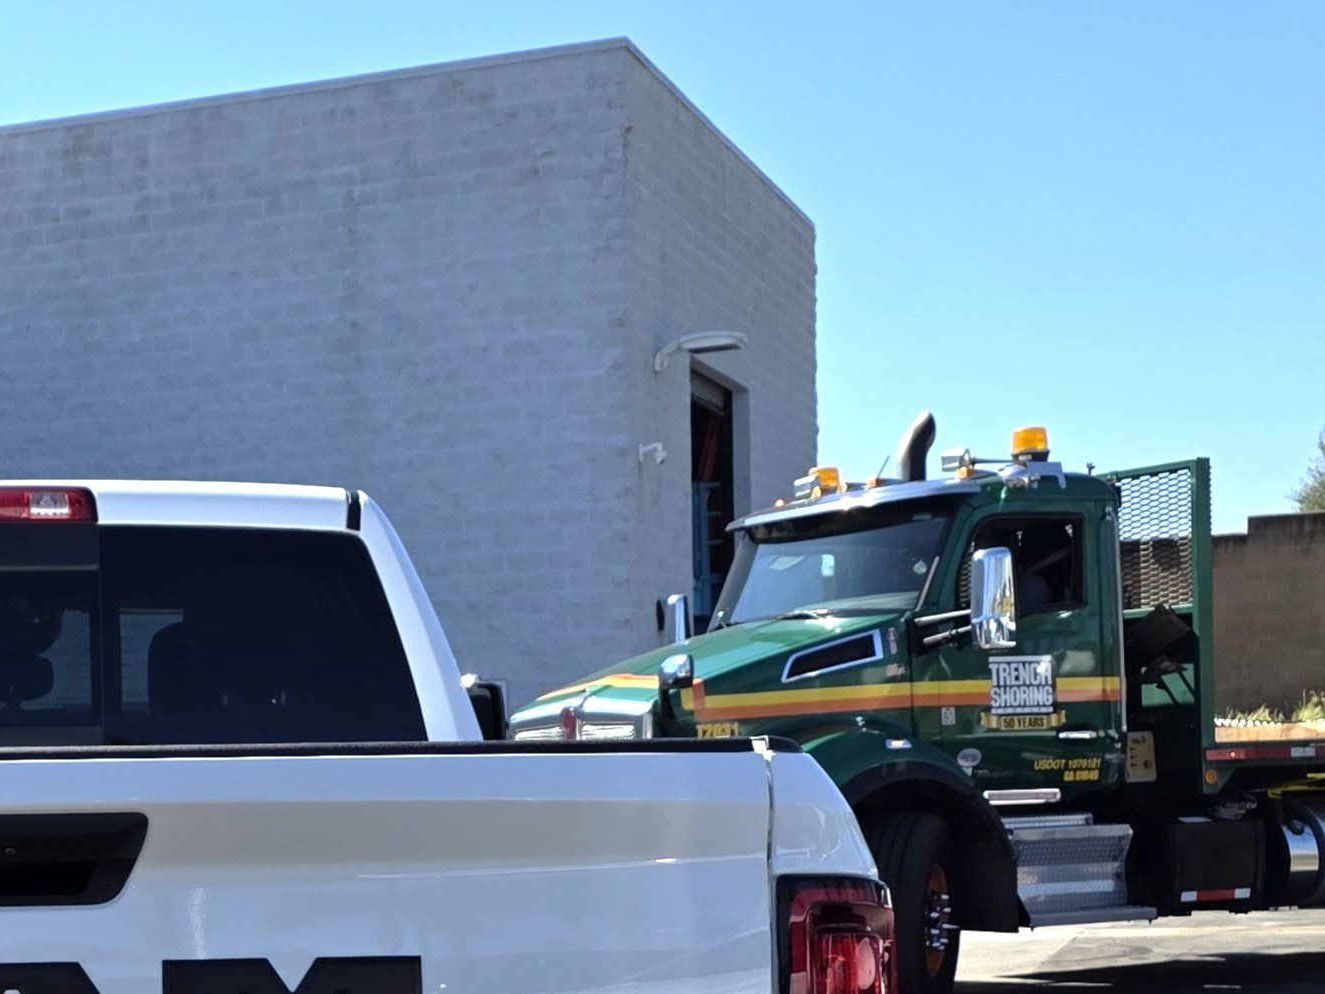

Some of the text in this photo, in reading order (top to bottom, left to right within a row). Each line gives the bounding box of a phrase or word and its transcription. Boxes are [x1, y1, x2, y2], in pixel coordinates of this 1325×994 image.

[989, 662, 1052, 686] TRENCH
[990, 686, 1053, 707] SHORING
[1003, 715, 1045, 729] 50 YEARS
[1034, 759, 1066, 770] USDOT
